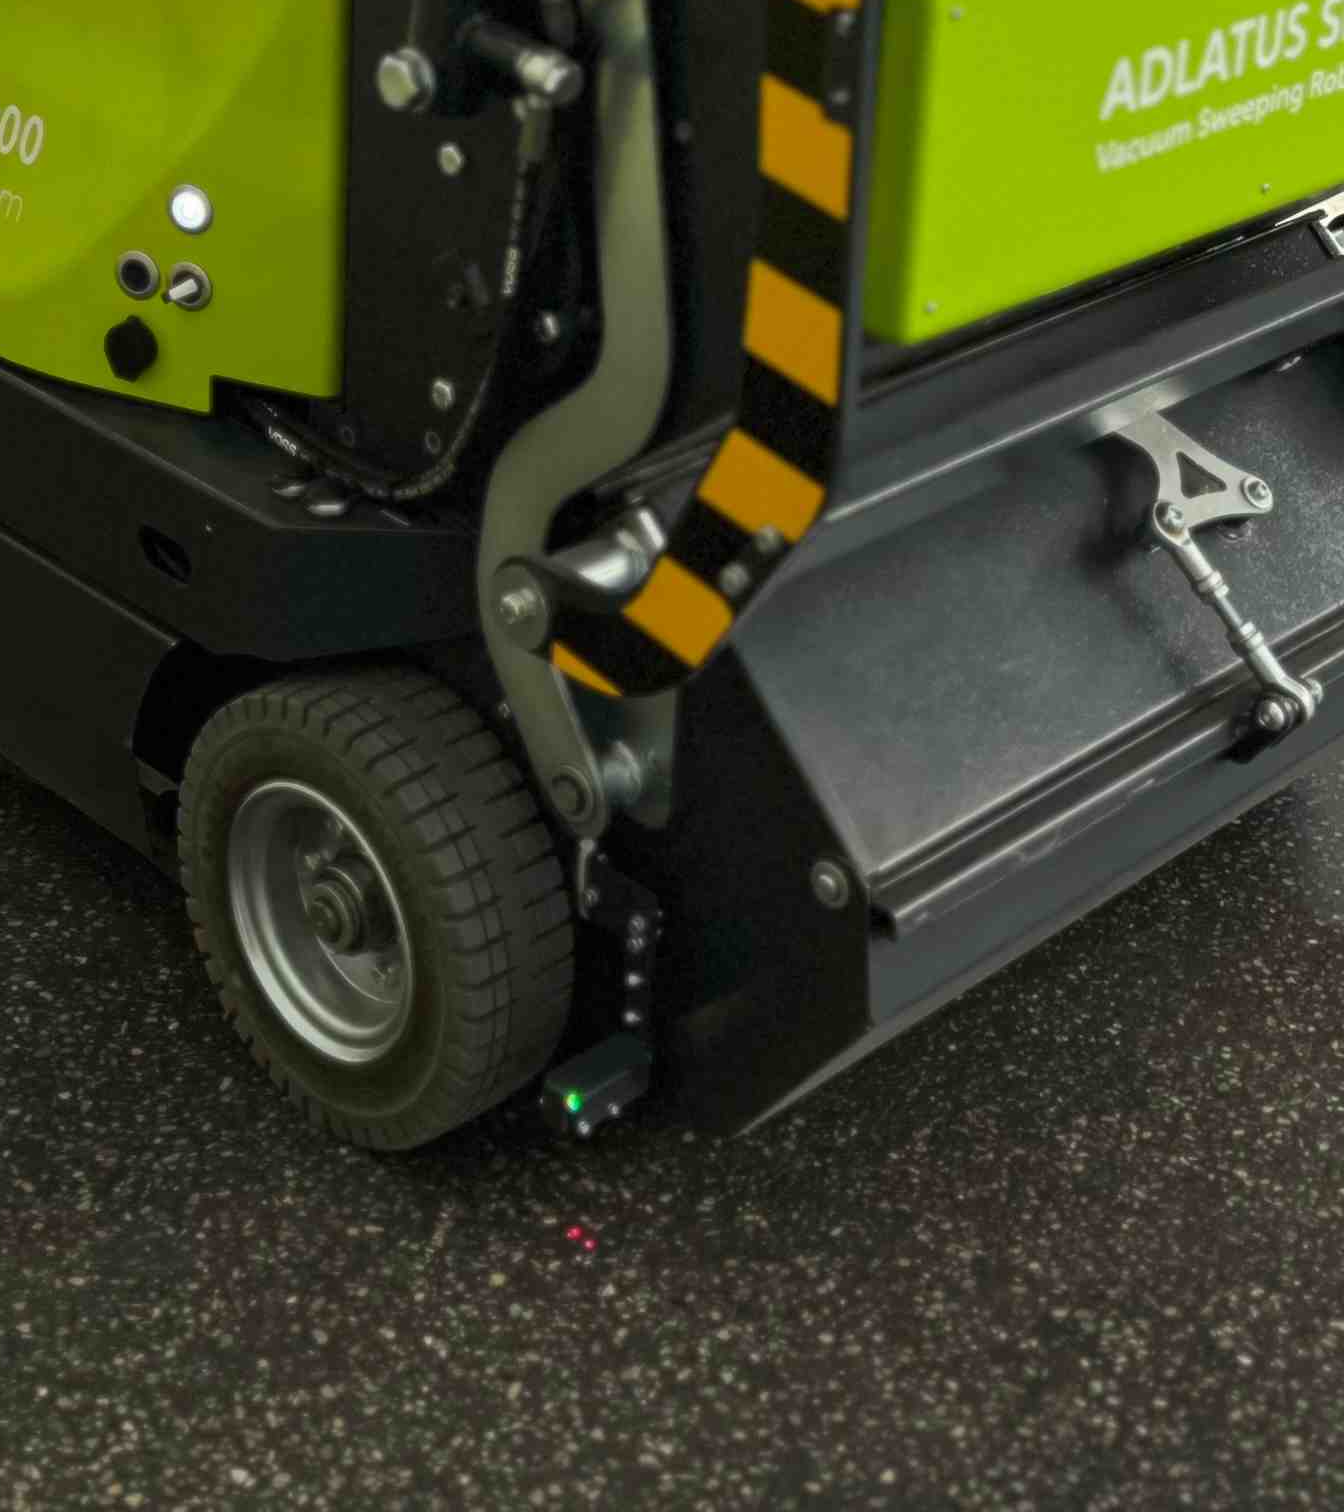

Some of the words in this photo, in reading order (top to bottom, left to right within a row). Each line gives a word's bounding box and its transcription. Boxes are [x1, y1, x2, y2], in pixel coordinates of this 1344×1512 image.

[1099, 1, 1311, 122] ADLATUS
[1094, 119, 1194, 175] Vacuum
[1196, 79, 1306, 139] Sweeping
